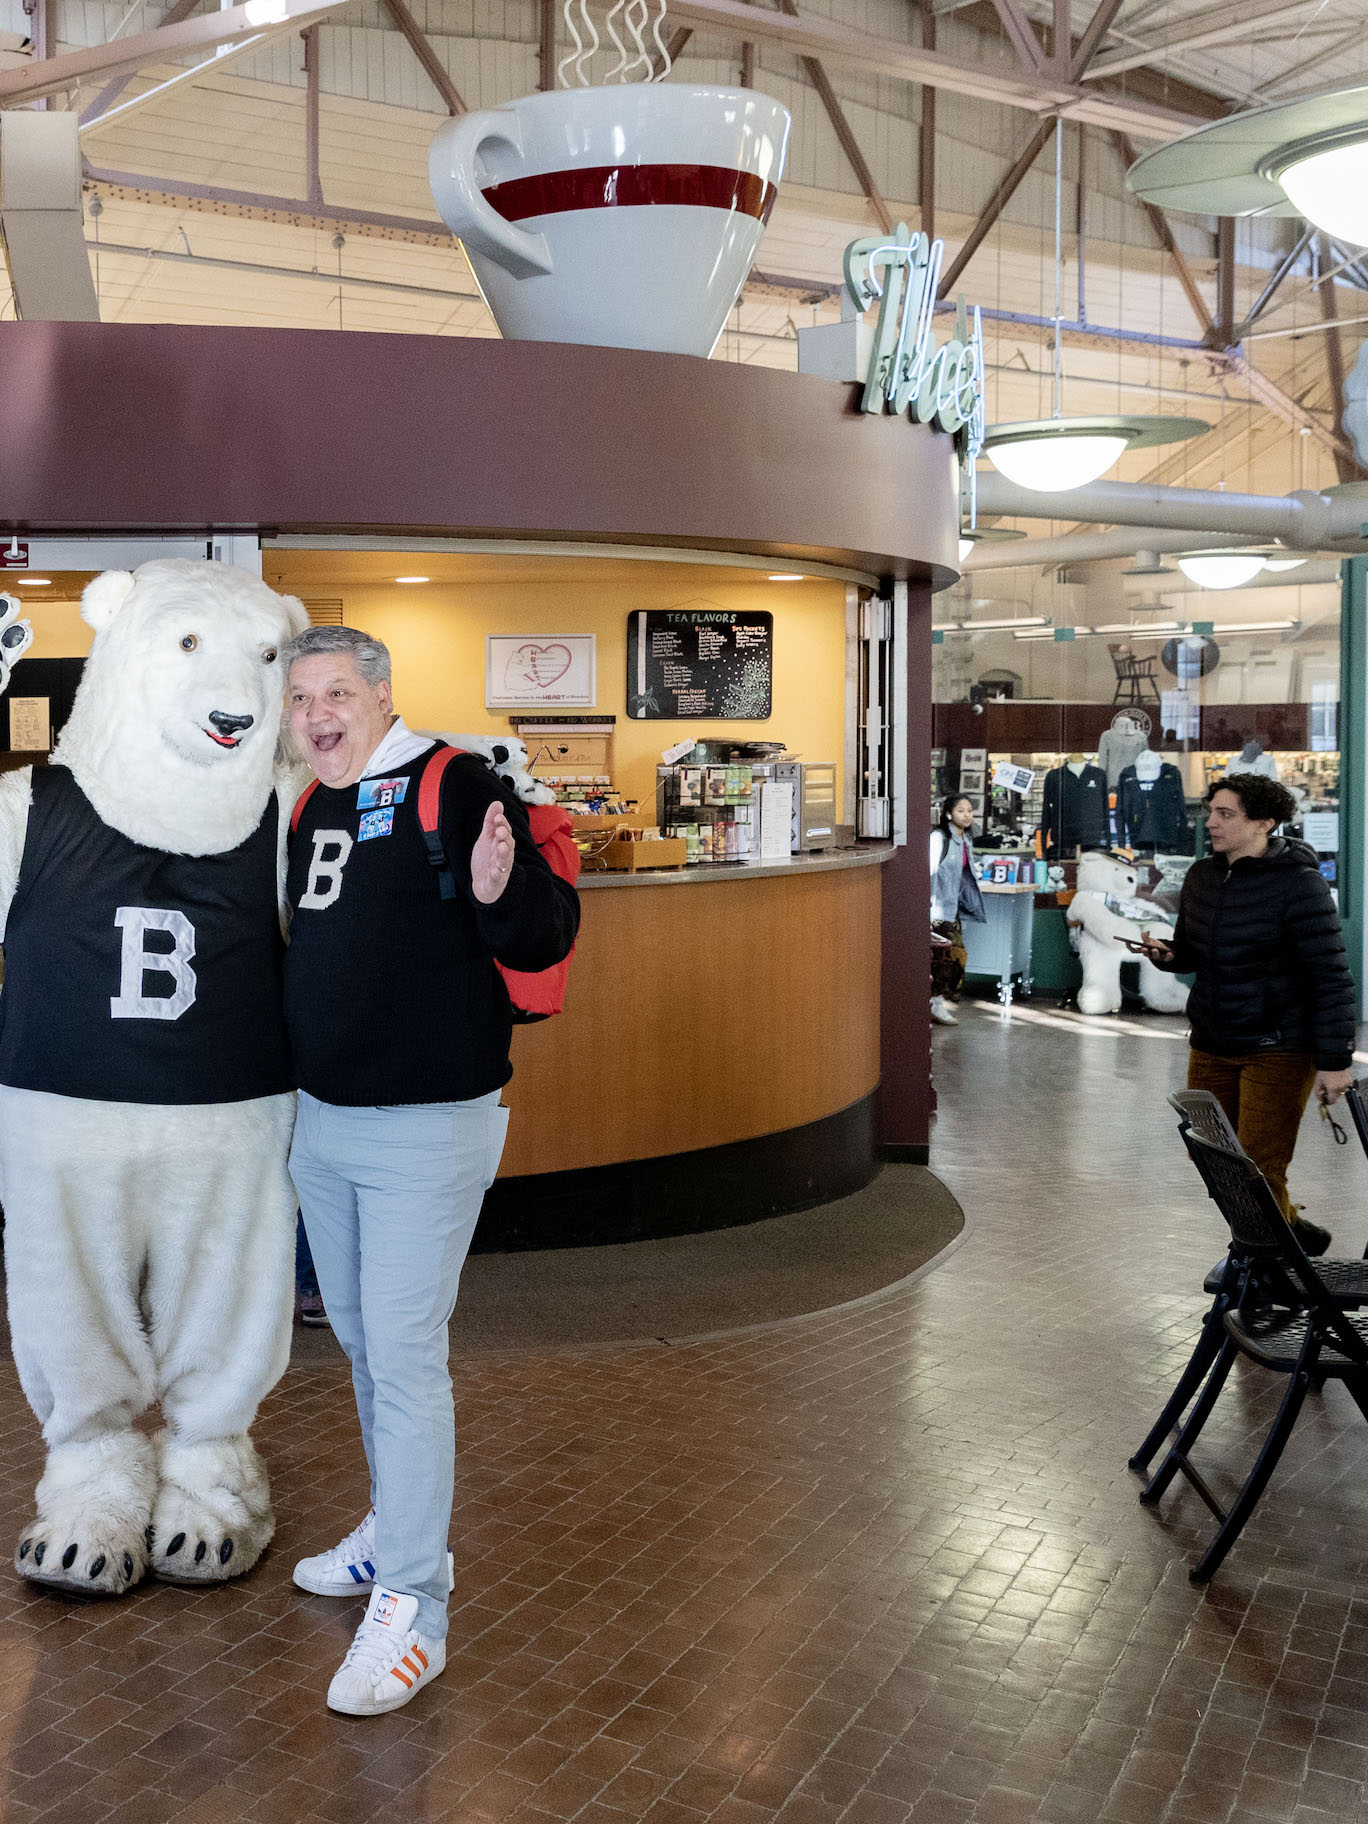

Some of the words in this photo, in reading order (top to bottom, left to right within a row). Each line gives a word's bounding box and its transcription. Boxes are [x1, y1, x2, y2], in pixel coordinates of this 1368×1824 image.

[667, 614, 688, 623] TEA
[692, 614, 737, 624] FLAVORS
[379, 789, 393, 807] B
[298, 829, 354, 910] B
[994, 865, 1007, 883] B
[110, 906, 197, 1021] B
